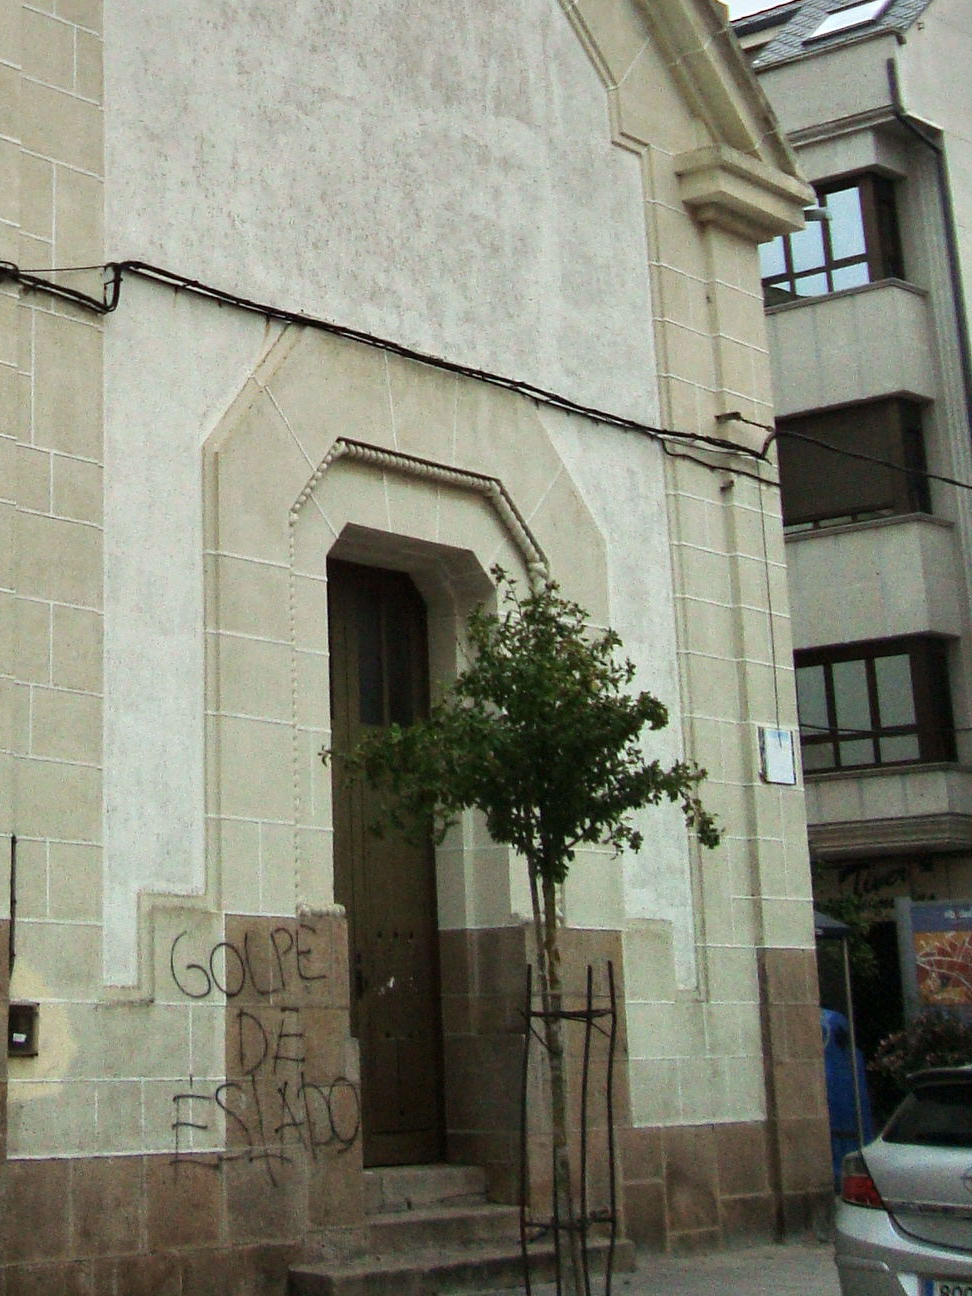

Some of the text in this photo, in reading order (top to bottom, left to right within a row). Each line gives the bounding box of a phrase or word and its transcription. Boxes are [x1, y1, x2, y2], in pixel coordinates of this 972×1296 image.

[170, 923, 327, 999] GOLPE
[236, 1007, 305, 1075] DE
[169, 1071, 361, 1188] ESTADO
